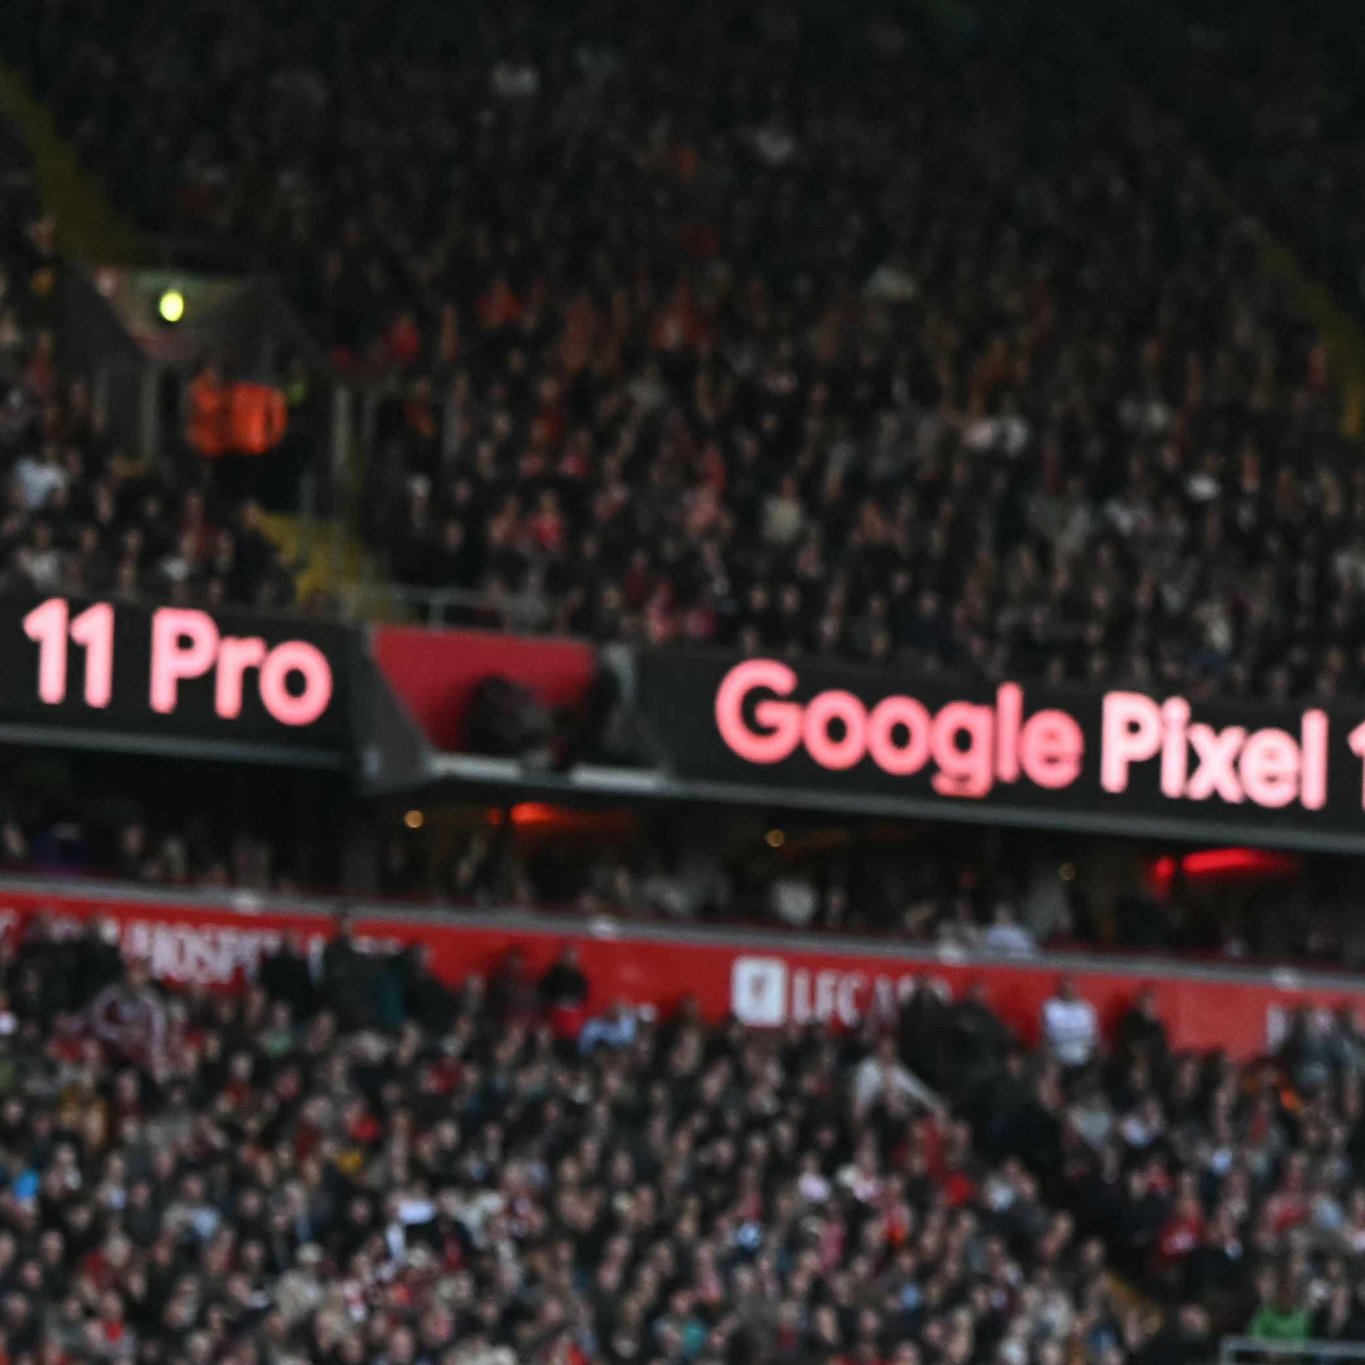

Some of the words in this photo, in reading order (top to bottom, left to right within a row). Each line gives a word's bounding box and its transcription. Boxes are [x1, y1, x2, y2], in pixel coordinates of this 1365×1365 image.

[23, 597, 115, 708] 11
[149, 606, 333, 726] Pro
[715, 657, 1085, 799] Google
[1100, 690, 1329, 810] Pixel
